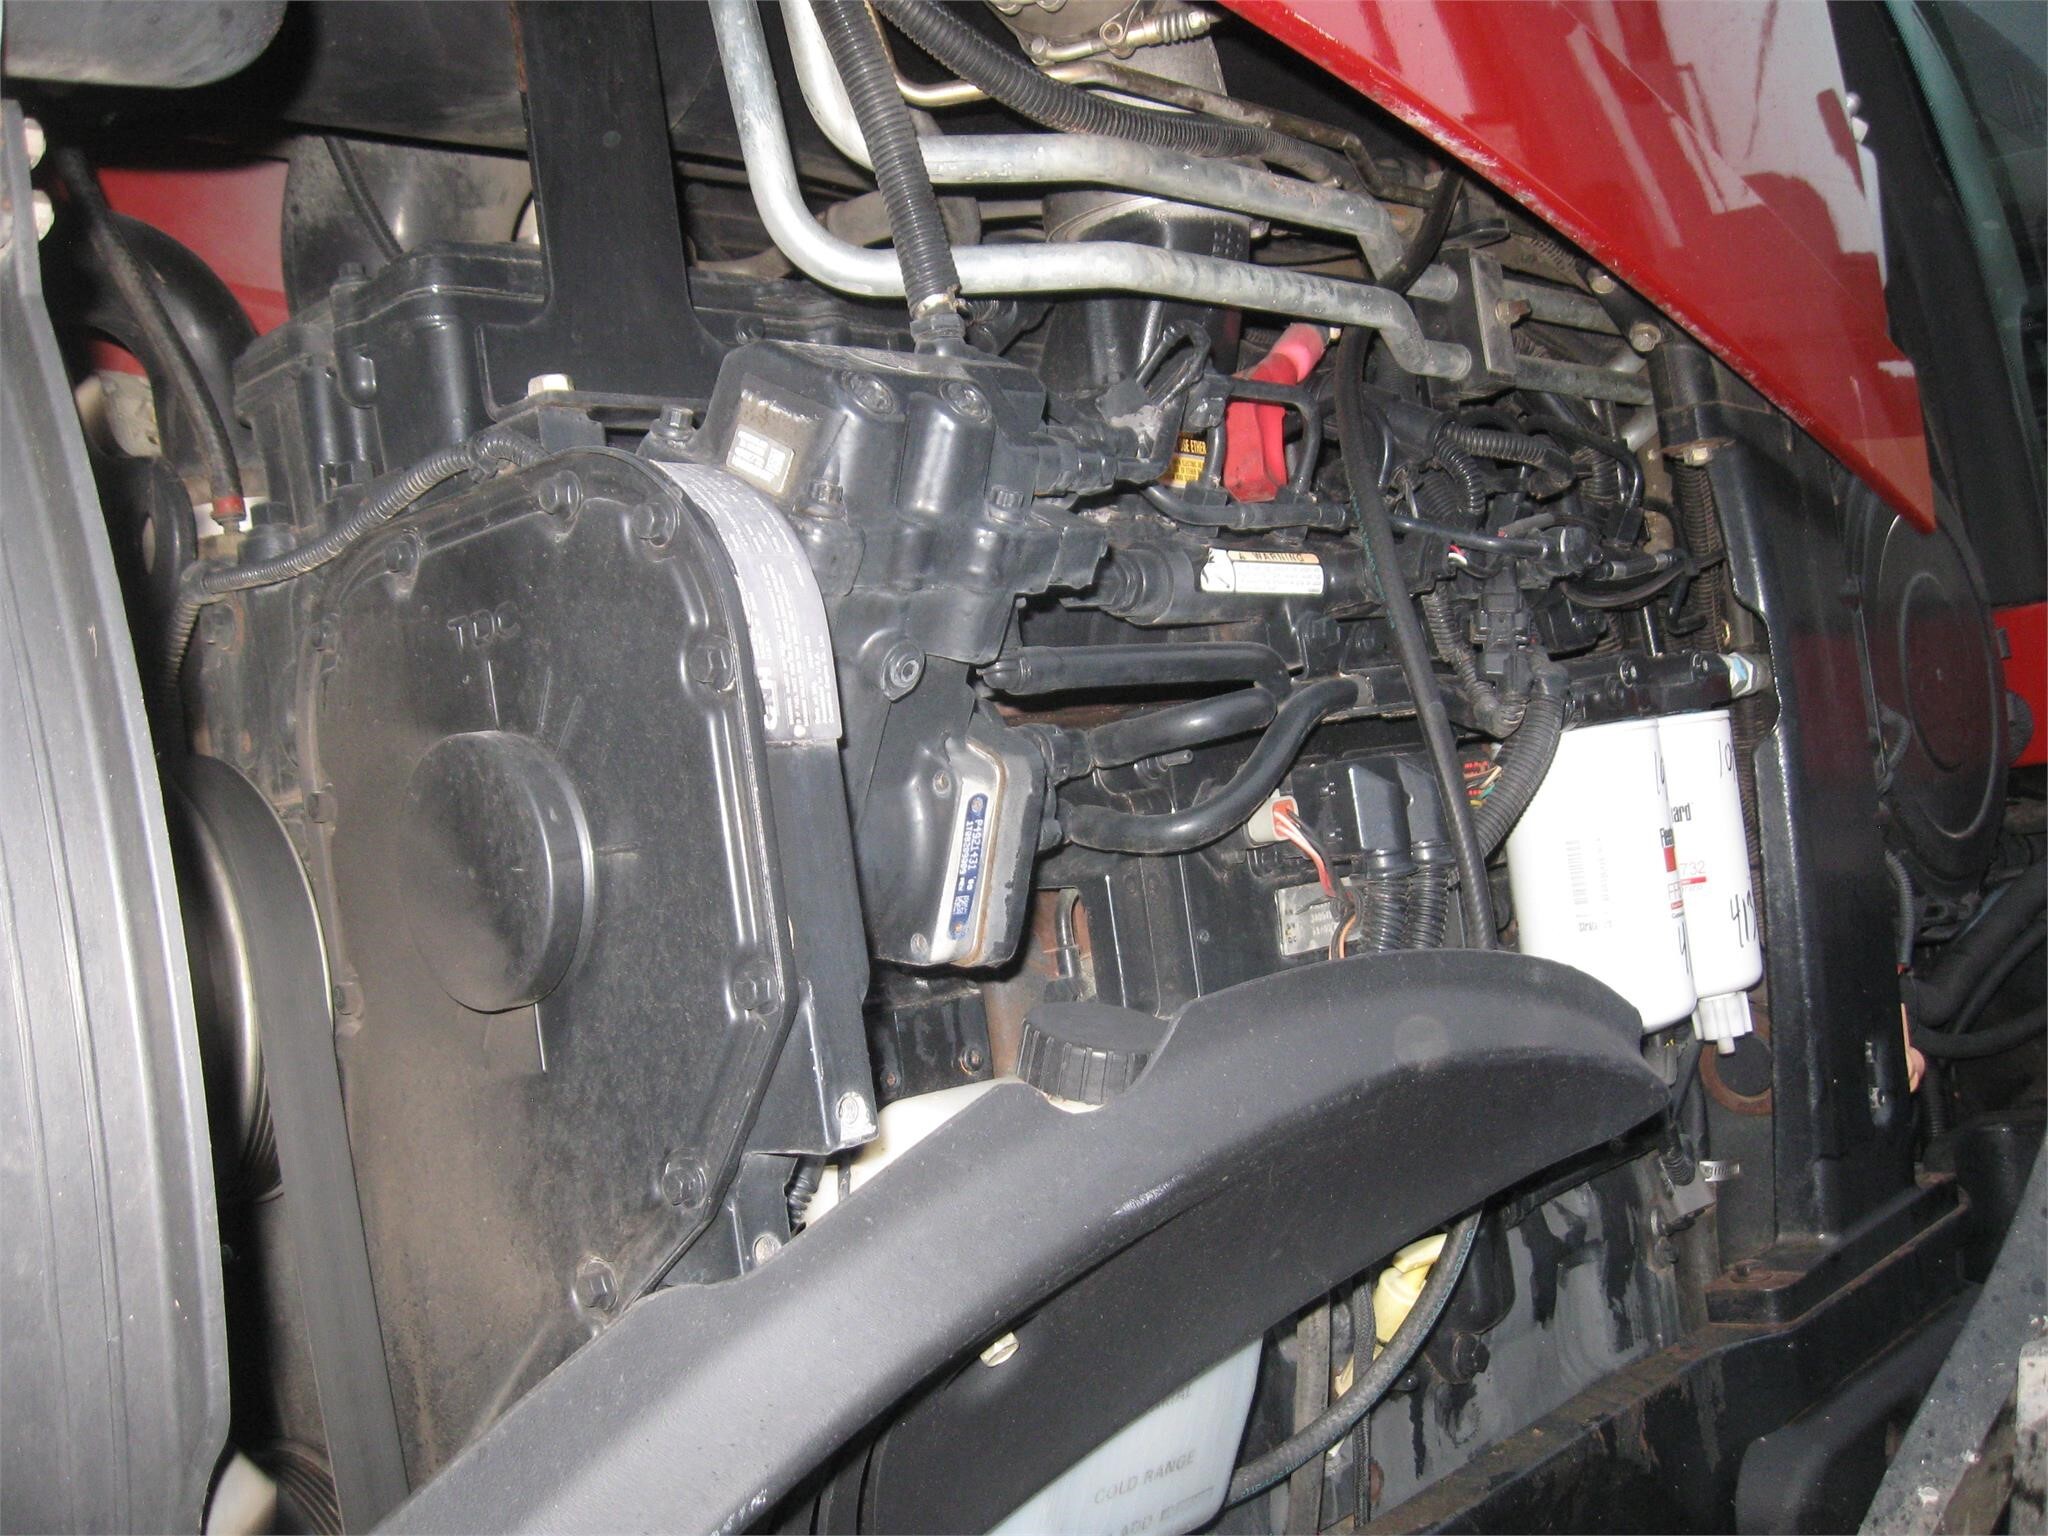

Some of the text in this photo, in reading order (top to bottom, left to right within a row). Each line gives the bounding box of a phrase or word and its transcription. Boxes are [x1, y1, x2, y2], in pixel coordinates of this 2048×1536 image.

[1252, 551, 1304, 562] WARNING
[447, 600, 521, 650] TDC
[1679, 860, 1706, 877] 732
[1094, 1450, 1196, 1505] COLD RANGE
